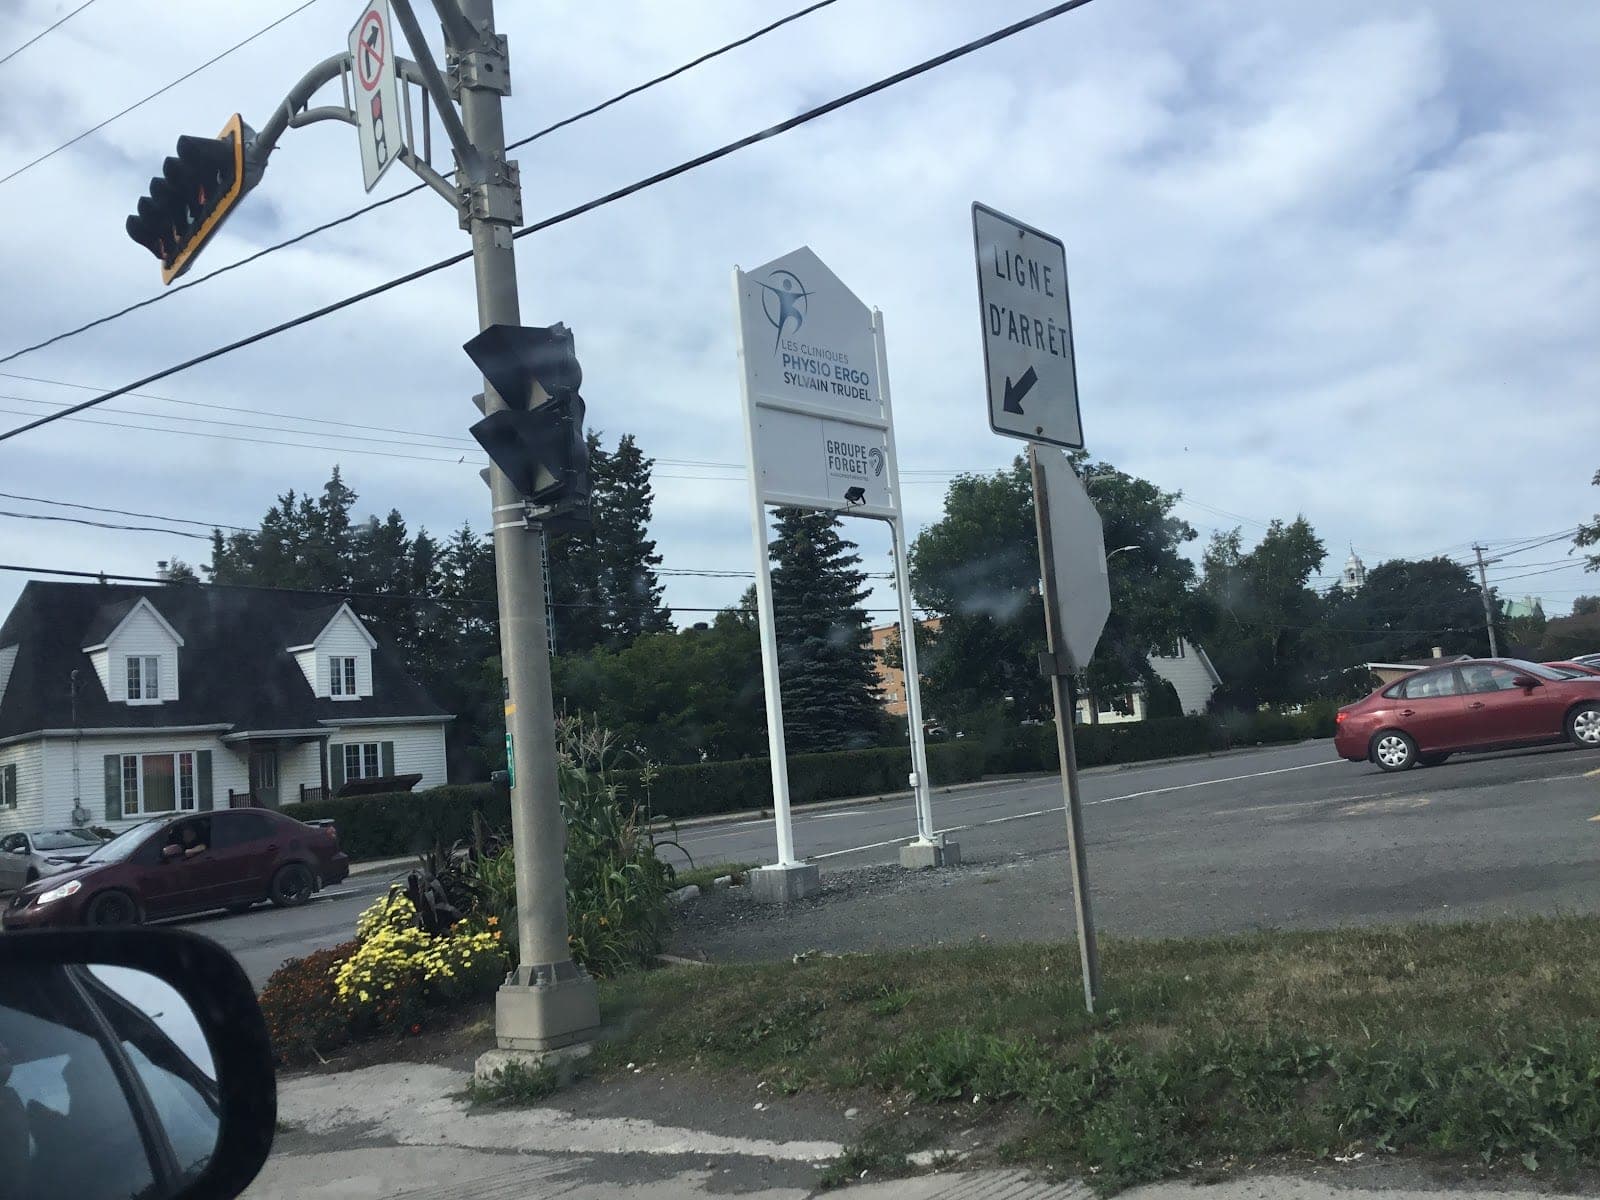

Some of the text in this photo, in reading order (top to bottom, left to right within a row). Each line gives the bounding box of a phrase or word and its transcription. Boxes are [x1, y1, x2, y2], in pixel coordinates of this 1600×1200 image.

[994, 245, 1054, 297] LIGNE
[989, 303, 1067, 358] D'ARRÊT
[781, 338, 849, 364] LES CLINIQUES
[783, 353, 869, 386] PHYSIO ERGO
[784, 372, 871, 401] SYLVAIN TRUDEL
[827, 440, 867, 459] GROUPE
[829, 456, 868, 475] FORGET
